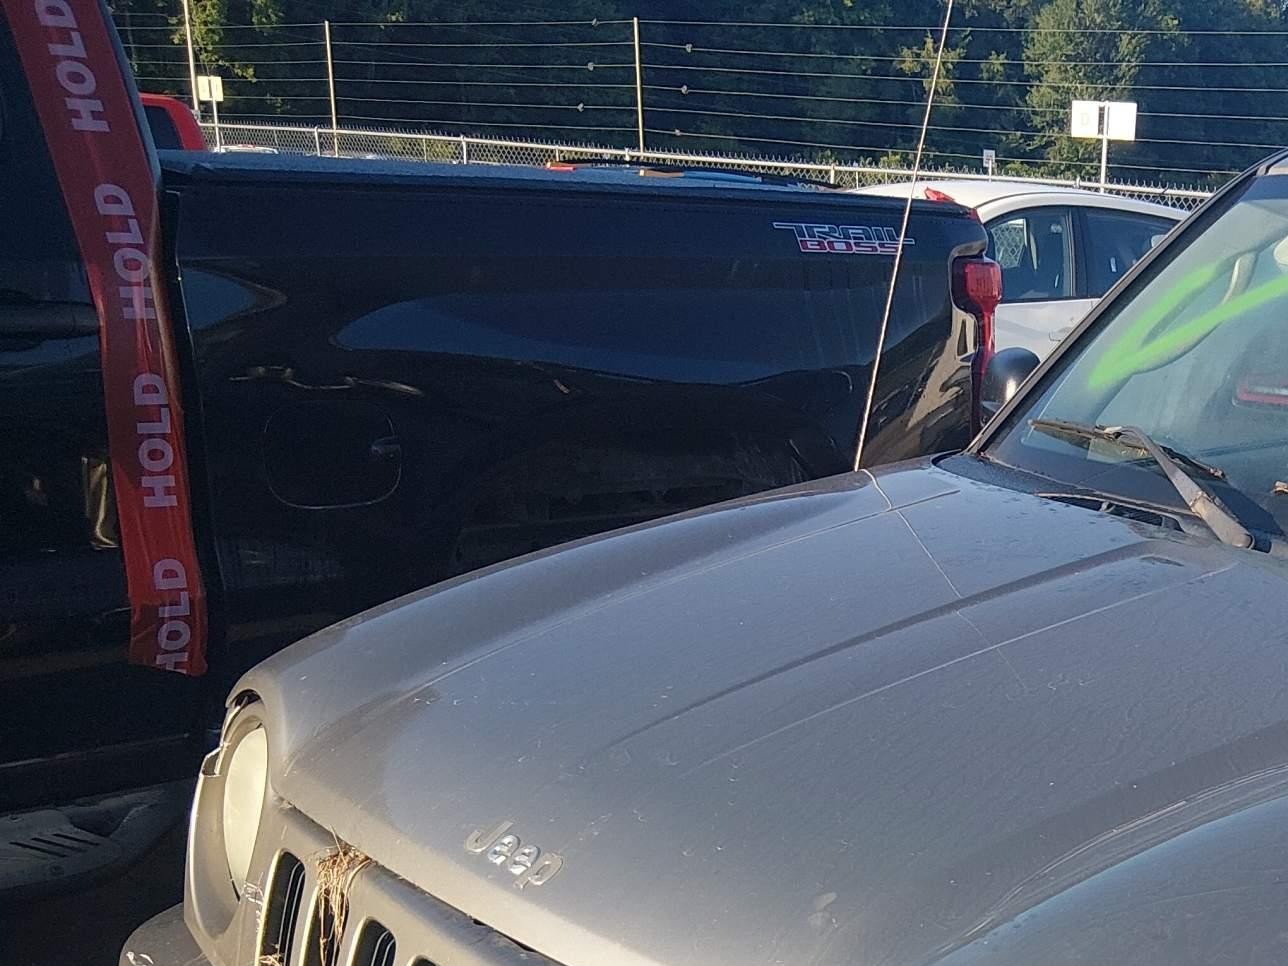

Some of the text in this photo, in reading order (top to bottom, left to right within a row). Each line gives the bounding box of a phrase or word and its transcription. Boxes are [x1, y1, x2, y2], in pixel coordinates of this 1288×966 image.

[35, 0, 111, 133] HOLD
[94, 183, 157, 320] HOLD
[772, 222, 916, 245] TRAIL
[799, 237, 903, 255] BOSS
[133, 372, 178, 508] HOLD
[153, 558, 192, 674] HOLD
[464, 819, 564, 889] Jeep
